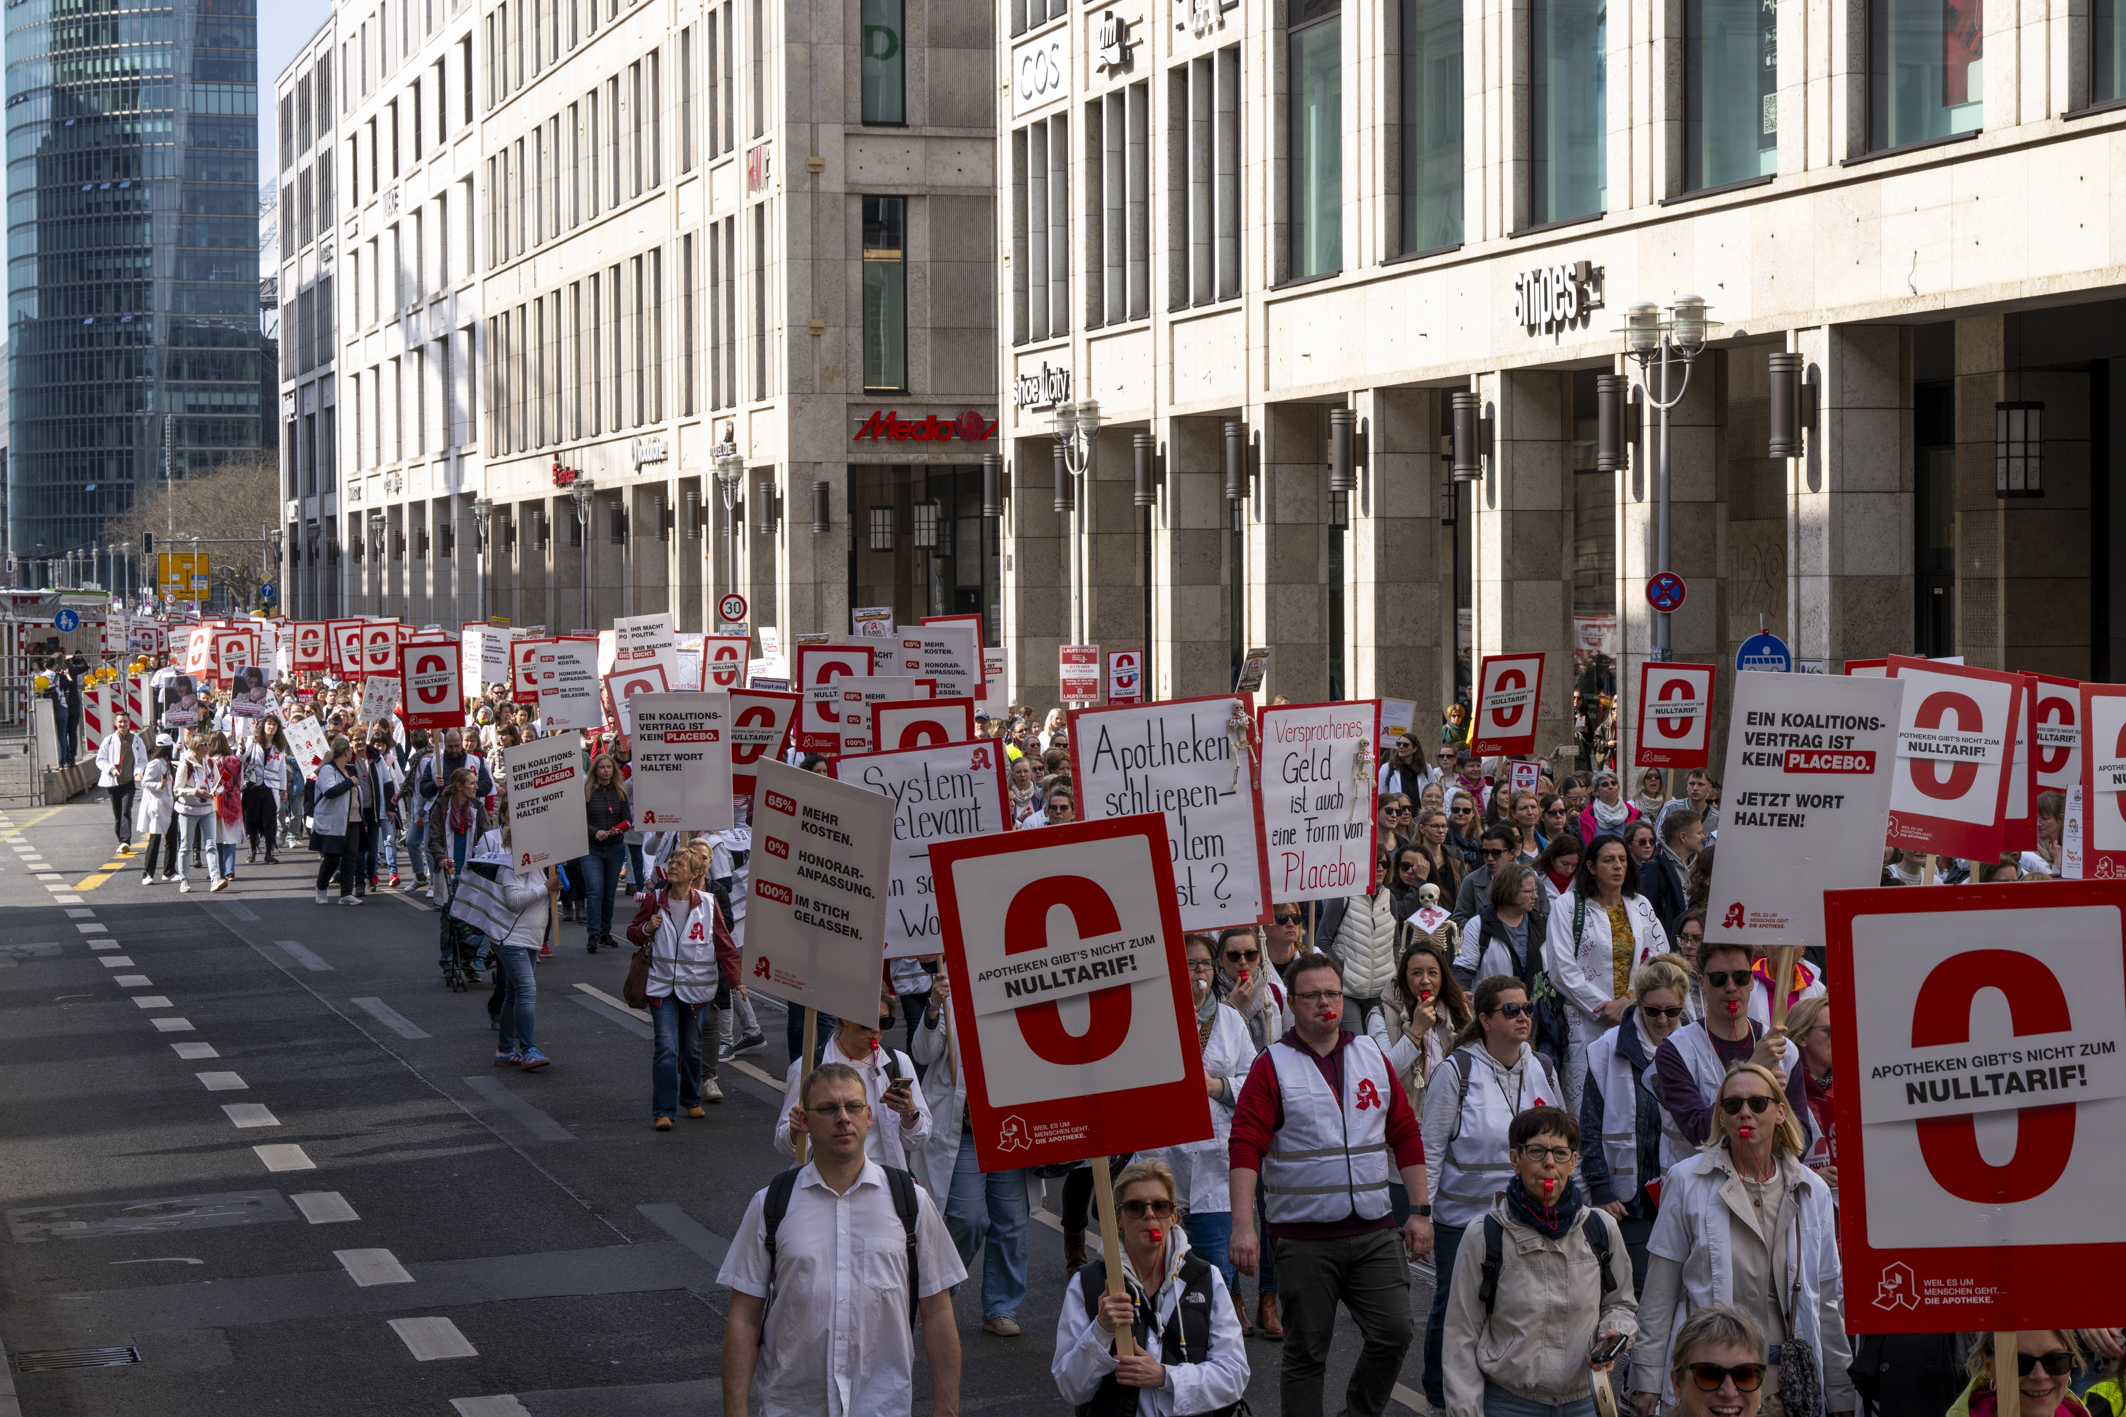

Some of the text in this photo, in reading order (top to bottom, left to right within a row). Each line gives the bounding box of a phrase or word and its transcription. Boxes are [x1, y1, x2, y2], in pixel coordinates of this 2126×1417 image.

[1021, 43, 1059, 100] COS
[1512, 261, 1578, 336] snipes
[1013, 366, 1068, 406] shoe city
[853, 410, 954, 441] Media
[725, 601, 742, 615] 30
[414, 677, 450, 686] NULLTARIF!
[1491, 695, 1527, 705] NULLTARIF!
[659, 712, 722, 720] KOALITIONS-
[1746, 711, 1886, 731] EIN KOALITIONS-
[667, 732, 716, 741] PLACEBO.
[1274, 713, 1363, 753] Versprochenes
[1744, 732, 1855, 749] VERTRAG IST
[1898, 732, 1936, 741] POTHEKEN
[512, 751, 576, 772] EIN KOALITIONS-
[1092, 714, 1230, 790] Apotheken
[1742, 752, 1871, 771] KEIN PLACEBO.
[1908, 741, 1986, 757] NULLTARIF!
[513, 763, 563, 782] VERTRAG IST
[641, 763, 682, 771] HALTEN!
[1282, 745, 1332, 784] Geld
[514, 770, 572, 791] KEIN PLACEBO.
[516, 790, 564, 810] JETZT WORT
[768, 794, 838, 827] 65% MEHR
[1290, 781, 1343, 814] ist auch
[1736, 791, 1844, 809] JETZT WORT
[516, 805, 549, 819] HALTEN!
[894, 797, 985, 841] elevant
[1734, 811, 1805, 828] HALTEN!
[801, 820, 853, 847] KOSTEN.
[1272, 817, 1363, 846] eine Form von
[767, 840, 864, 879] 0% HONORAR-
[1281, 845, 1355, 892] Placebo
[797, 866, 876, 899] ANPASSUNG.
[758, 882, 850, 921] 100% IM STICH
[794, 909, 863, 941] GELASSEN.
[978, 935, 1157, 982] APOTHEKEN GIBT'S NICHT ZUM
[1004, 954, 1138, 998] NULLTARIF!
[1871, 1041, 2116, 1079] APOTHEKEN GIBT'S NICHT ZUM
[1905, 1064, 2087, 1105] NULLTARIF!
[1034, 1125, 1090, 1138] MENSCHEN GEHT.
[1048, 1133, 1086, 1142] APOTHEKE.
